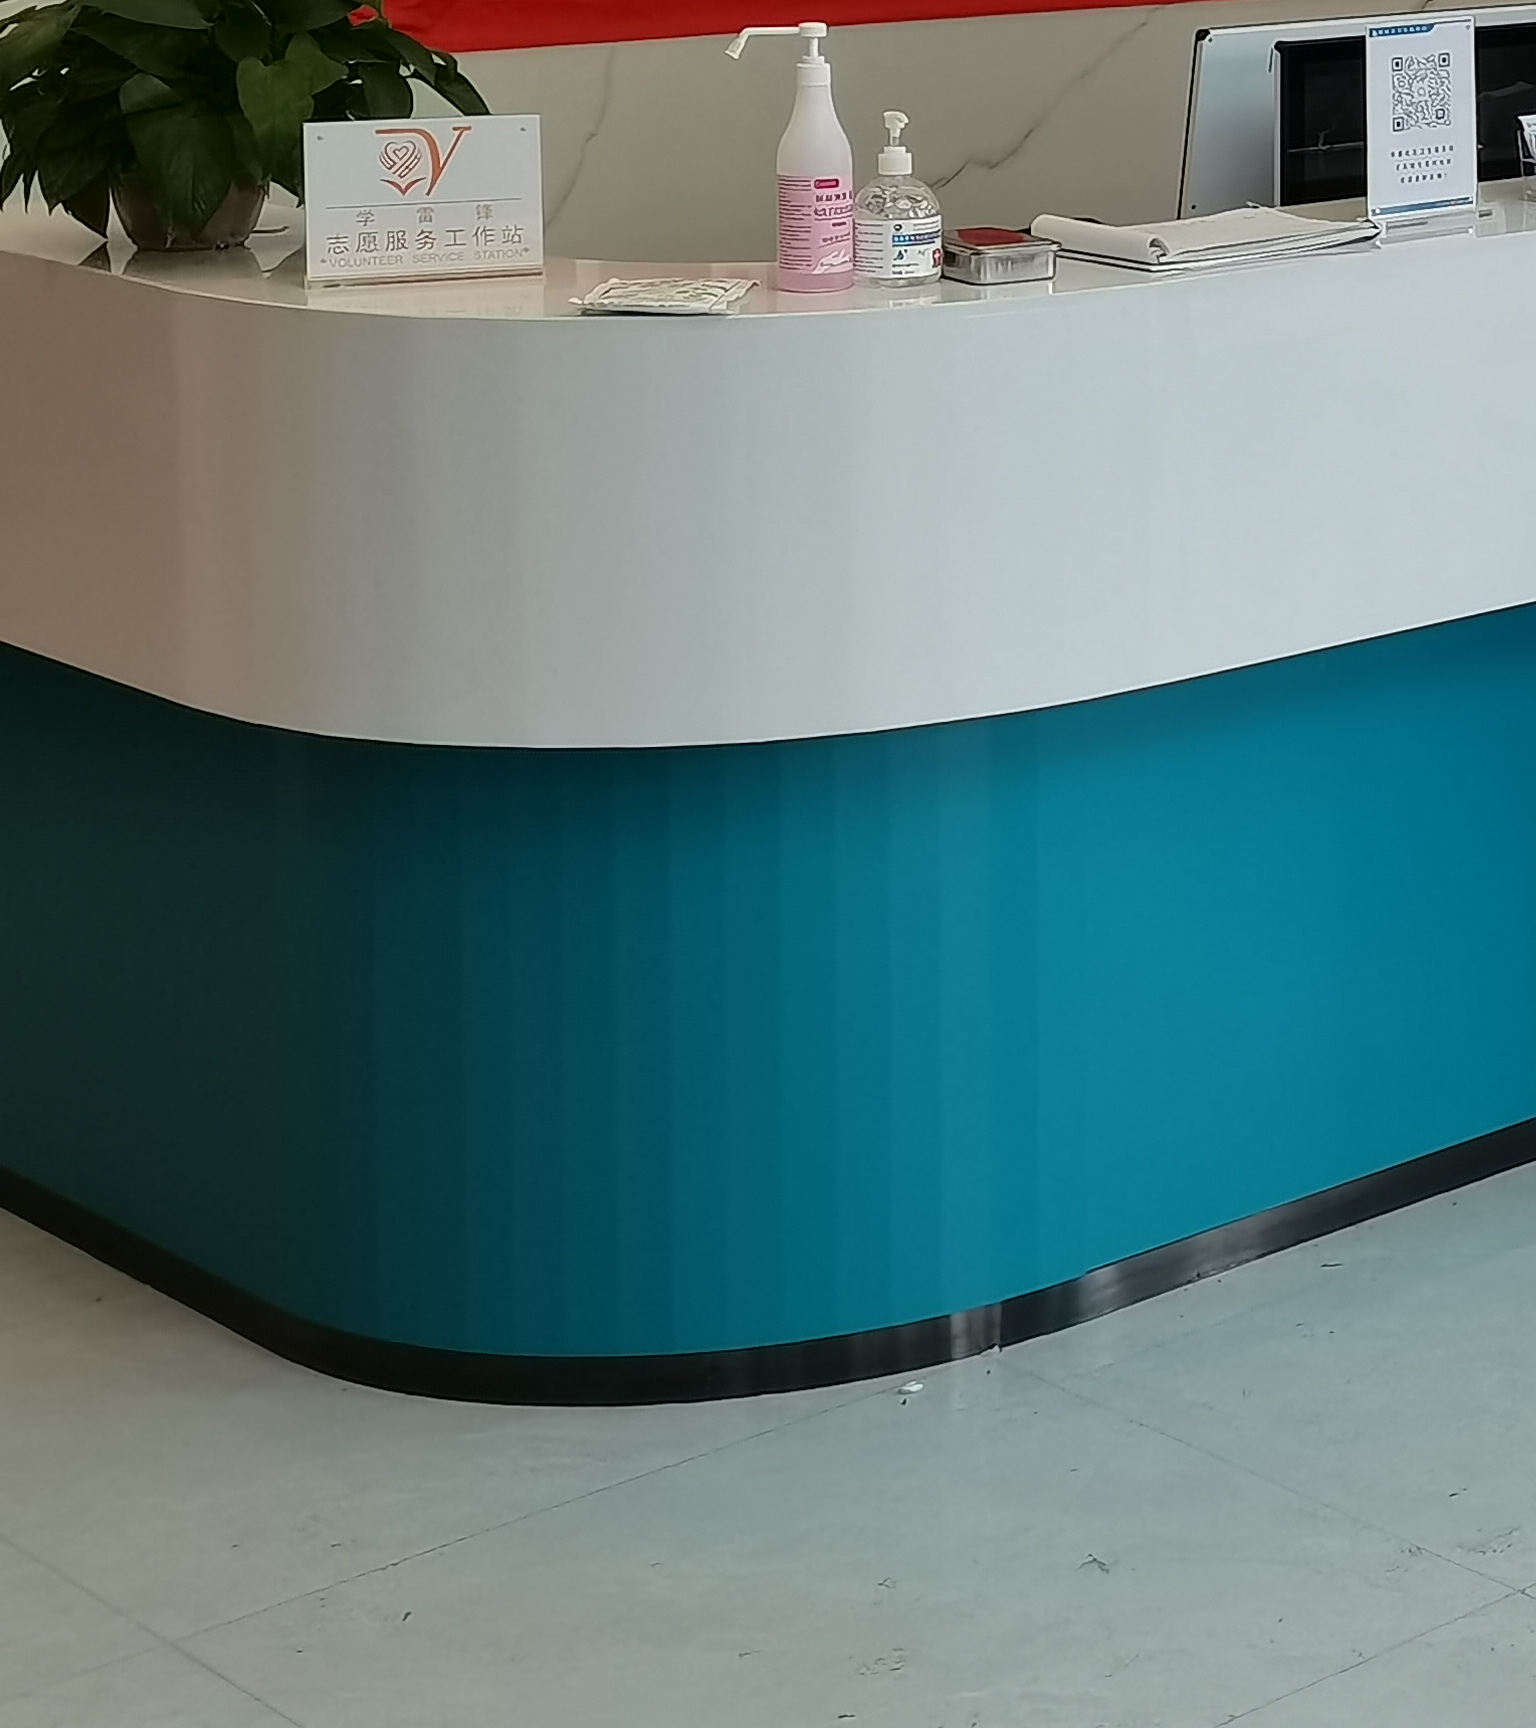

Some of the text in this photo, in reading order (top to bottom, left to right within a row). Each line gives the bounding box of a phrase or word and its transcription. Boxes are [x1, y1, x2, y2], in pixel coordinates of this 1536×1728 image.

[326, 224, 525, 255] 志愿服务工作站
[329, 248, 524, 269] VOLUNTEER SERVICE STATION
